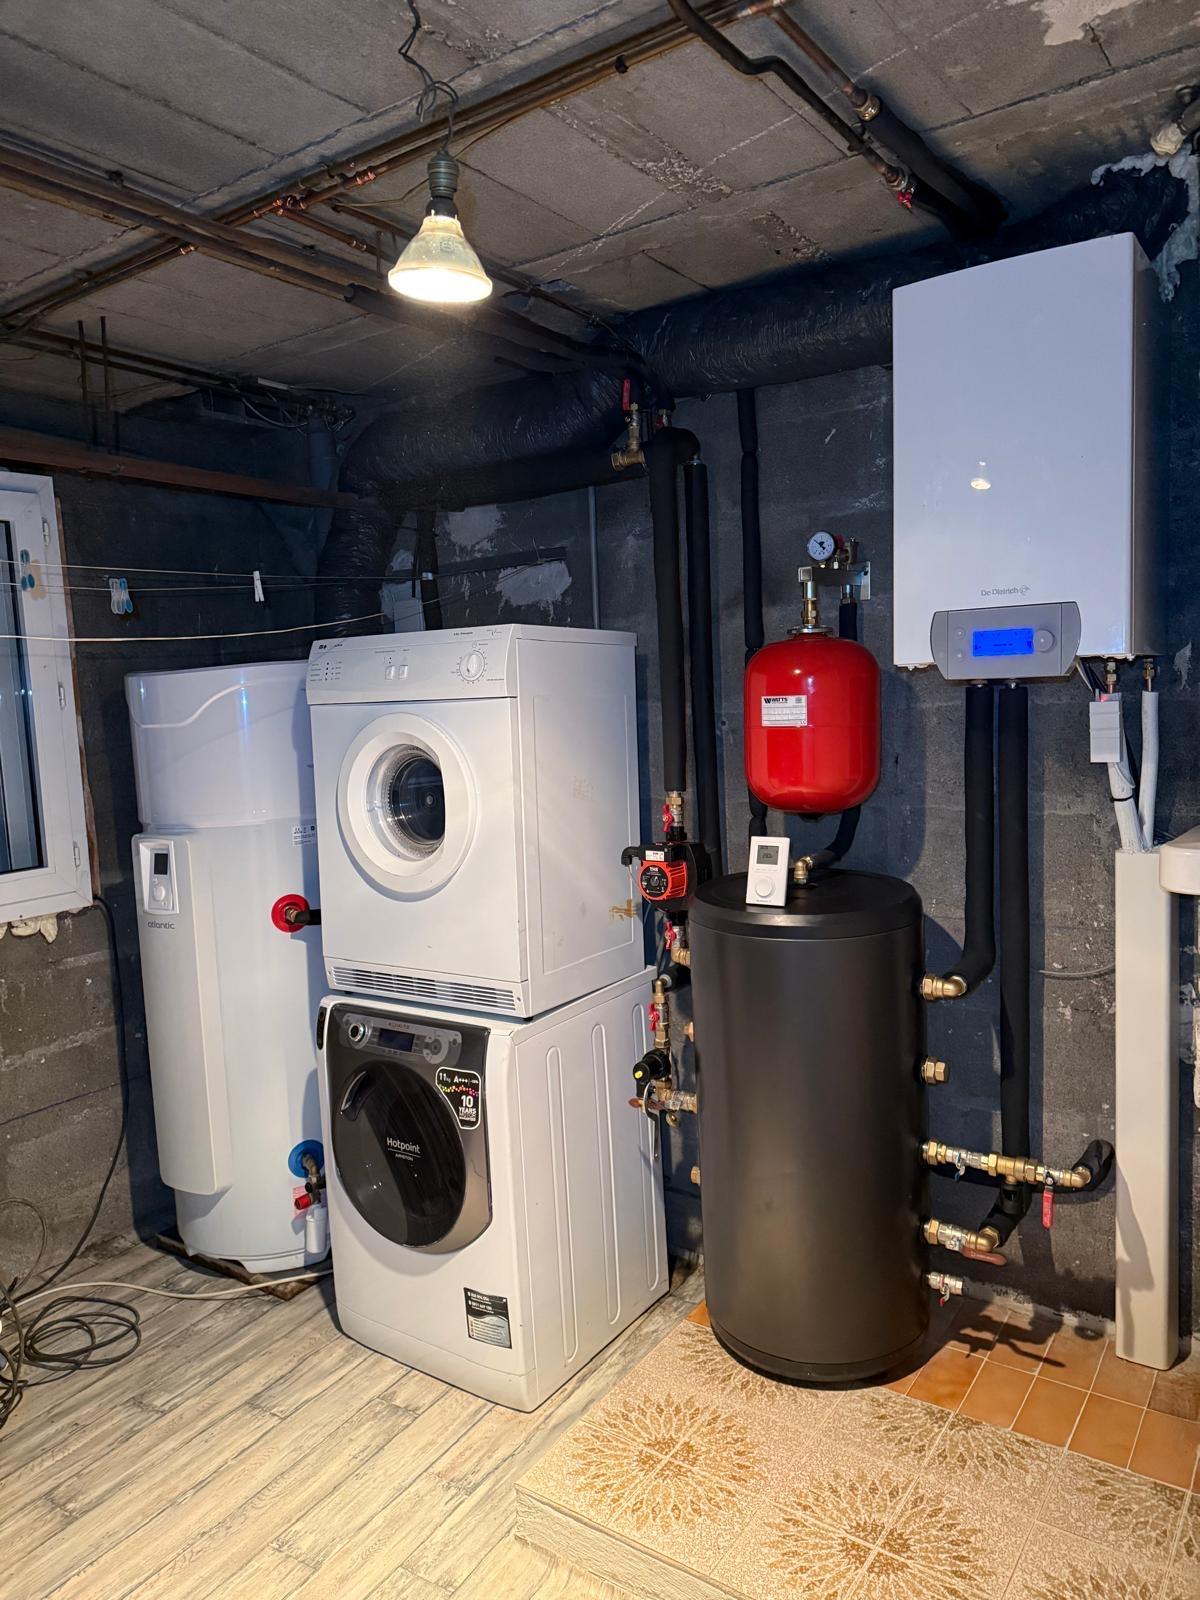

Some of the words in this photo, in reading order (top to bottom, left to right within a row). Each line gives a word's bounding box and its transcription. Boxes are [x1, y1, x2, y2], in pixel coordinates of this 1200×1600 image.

[147, 920, 176, 930] atlantic
[461, 1095, 474, 1108] 10
[386, 1136, 421, 1154] Hotpoint
